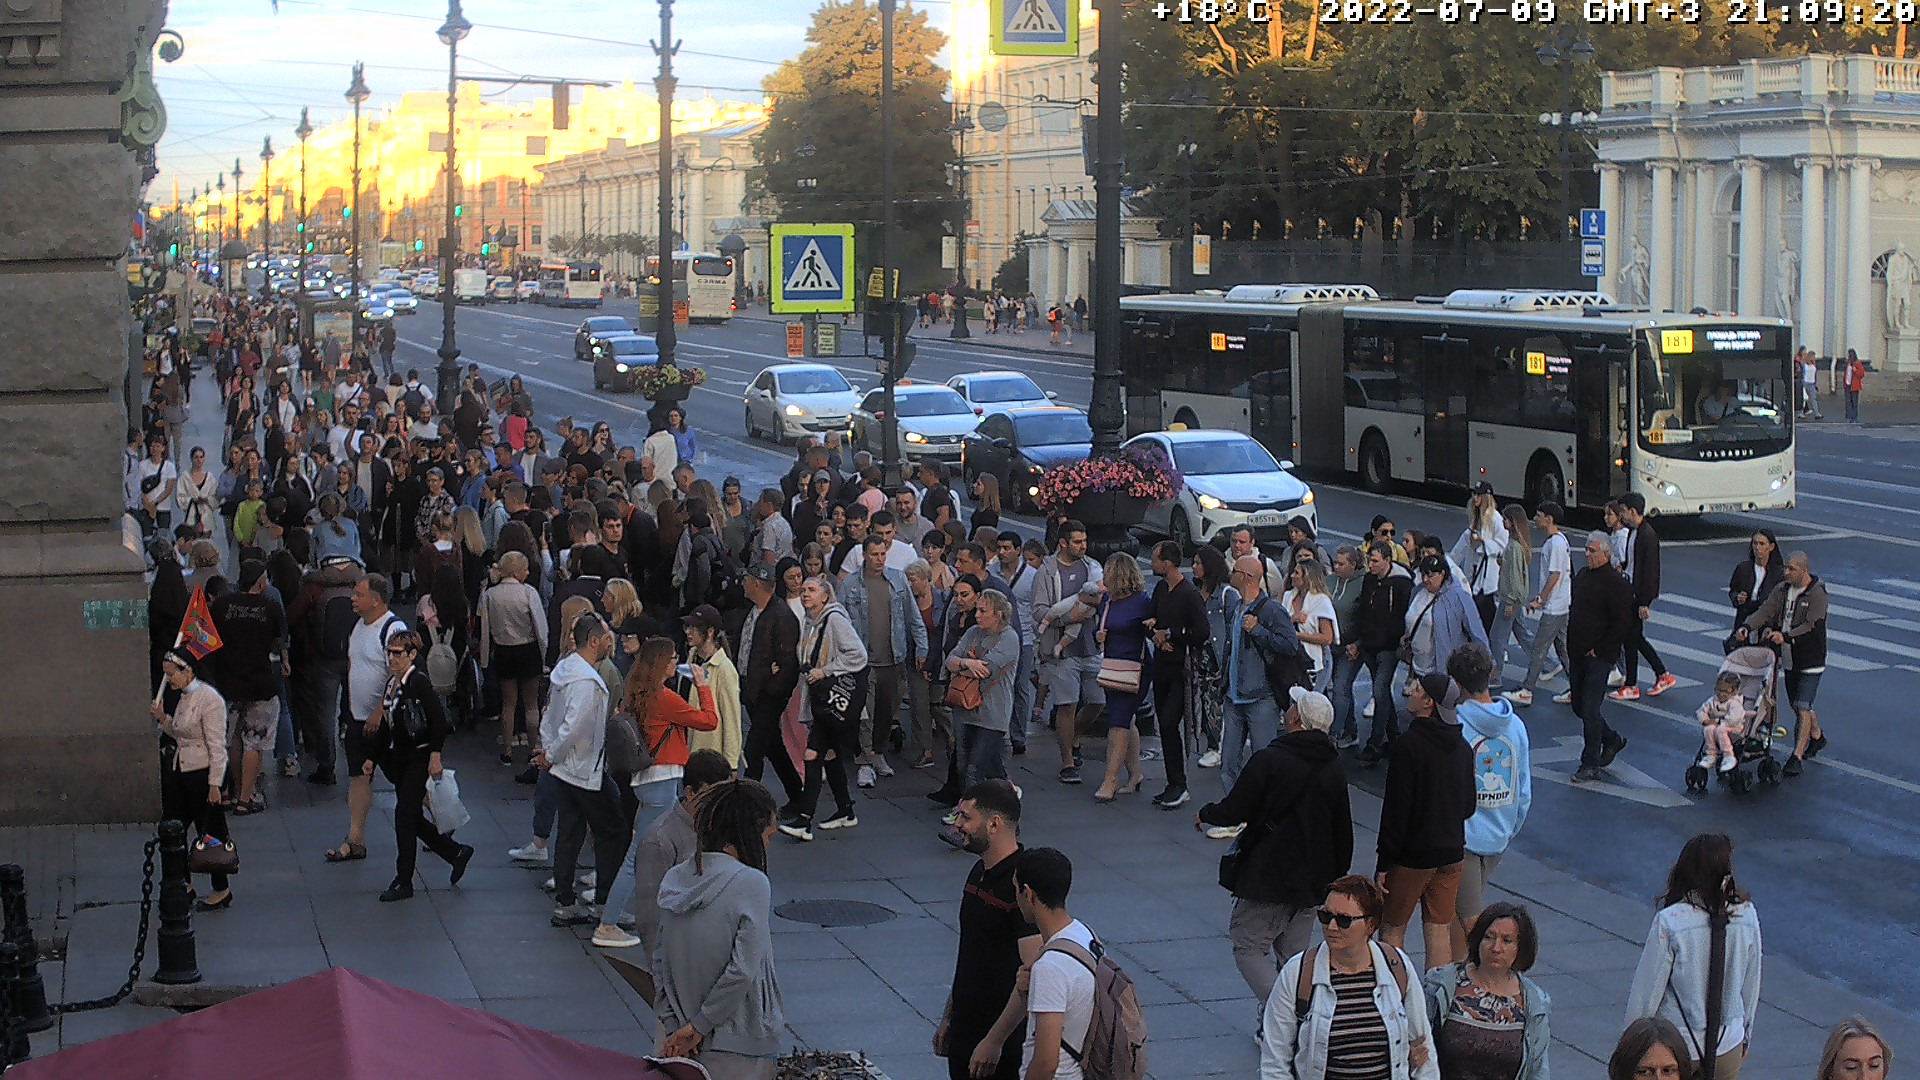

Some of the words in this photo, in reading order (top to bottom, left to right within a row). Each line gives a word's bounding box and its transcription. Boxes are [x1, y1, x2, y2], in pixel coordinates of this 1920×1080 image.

[1665, 336, 1688, 347] 181
[1699, 449, 1754, 458] VOLGABUS
[1478, 791, 1510, 800] IPNDIP
